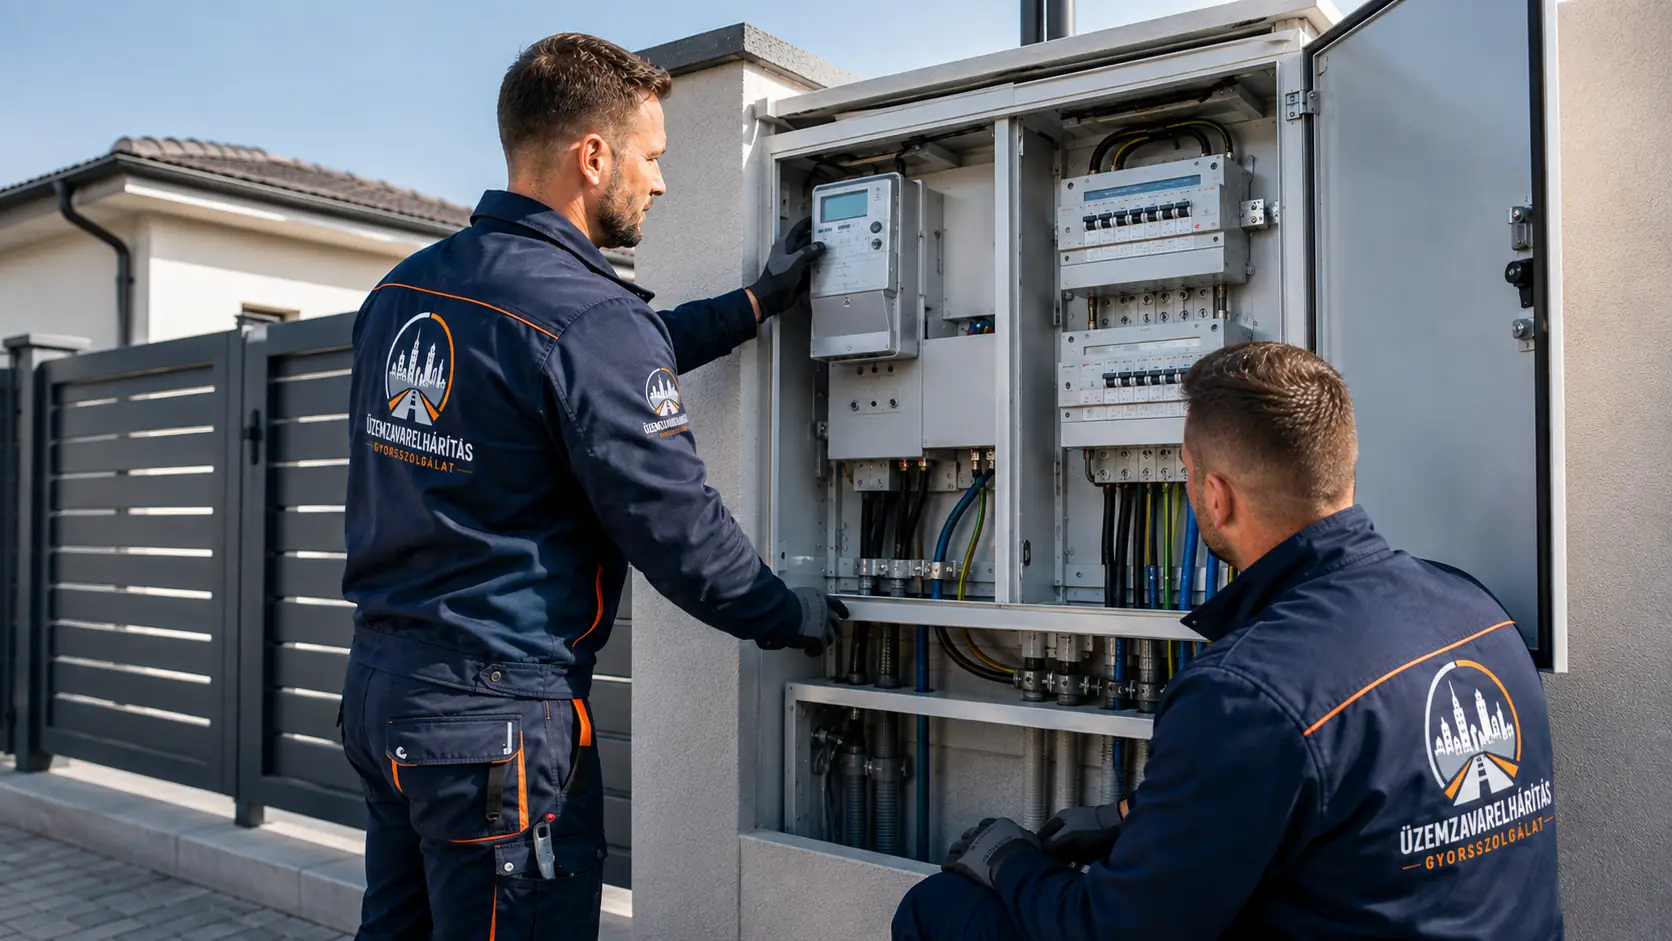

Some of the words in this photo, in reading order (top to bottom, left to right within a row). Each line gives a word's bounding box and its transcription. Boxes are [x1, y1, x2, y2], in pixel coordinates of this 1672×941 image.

[366, 413, 473, 462] ÜZEMZAVARELHÁRÍTÁS
[374, 442, 455, 473] GYORSSZOLGÁLAT
[1400, 778, 1552, 855] ÜZEMZAVARELHÁRÍTÁS
[1425, 816, 1543, 870] GYORSSZOLGÁLAT
